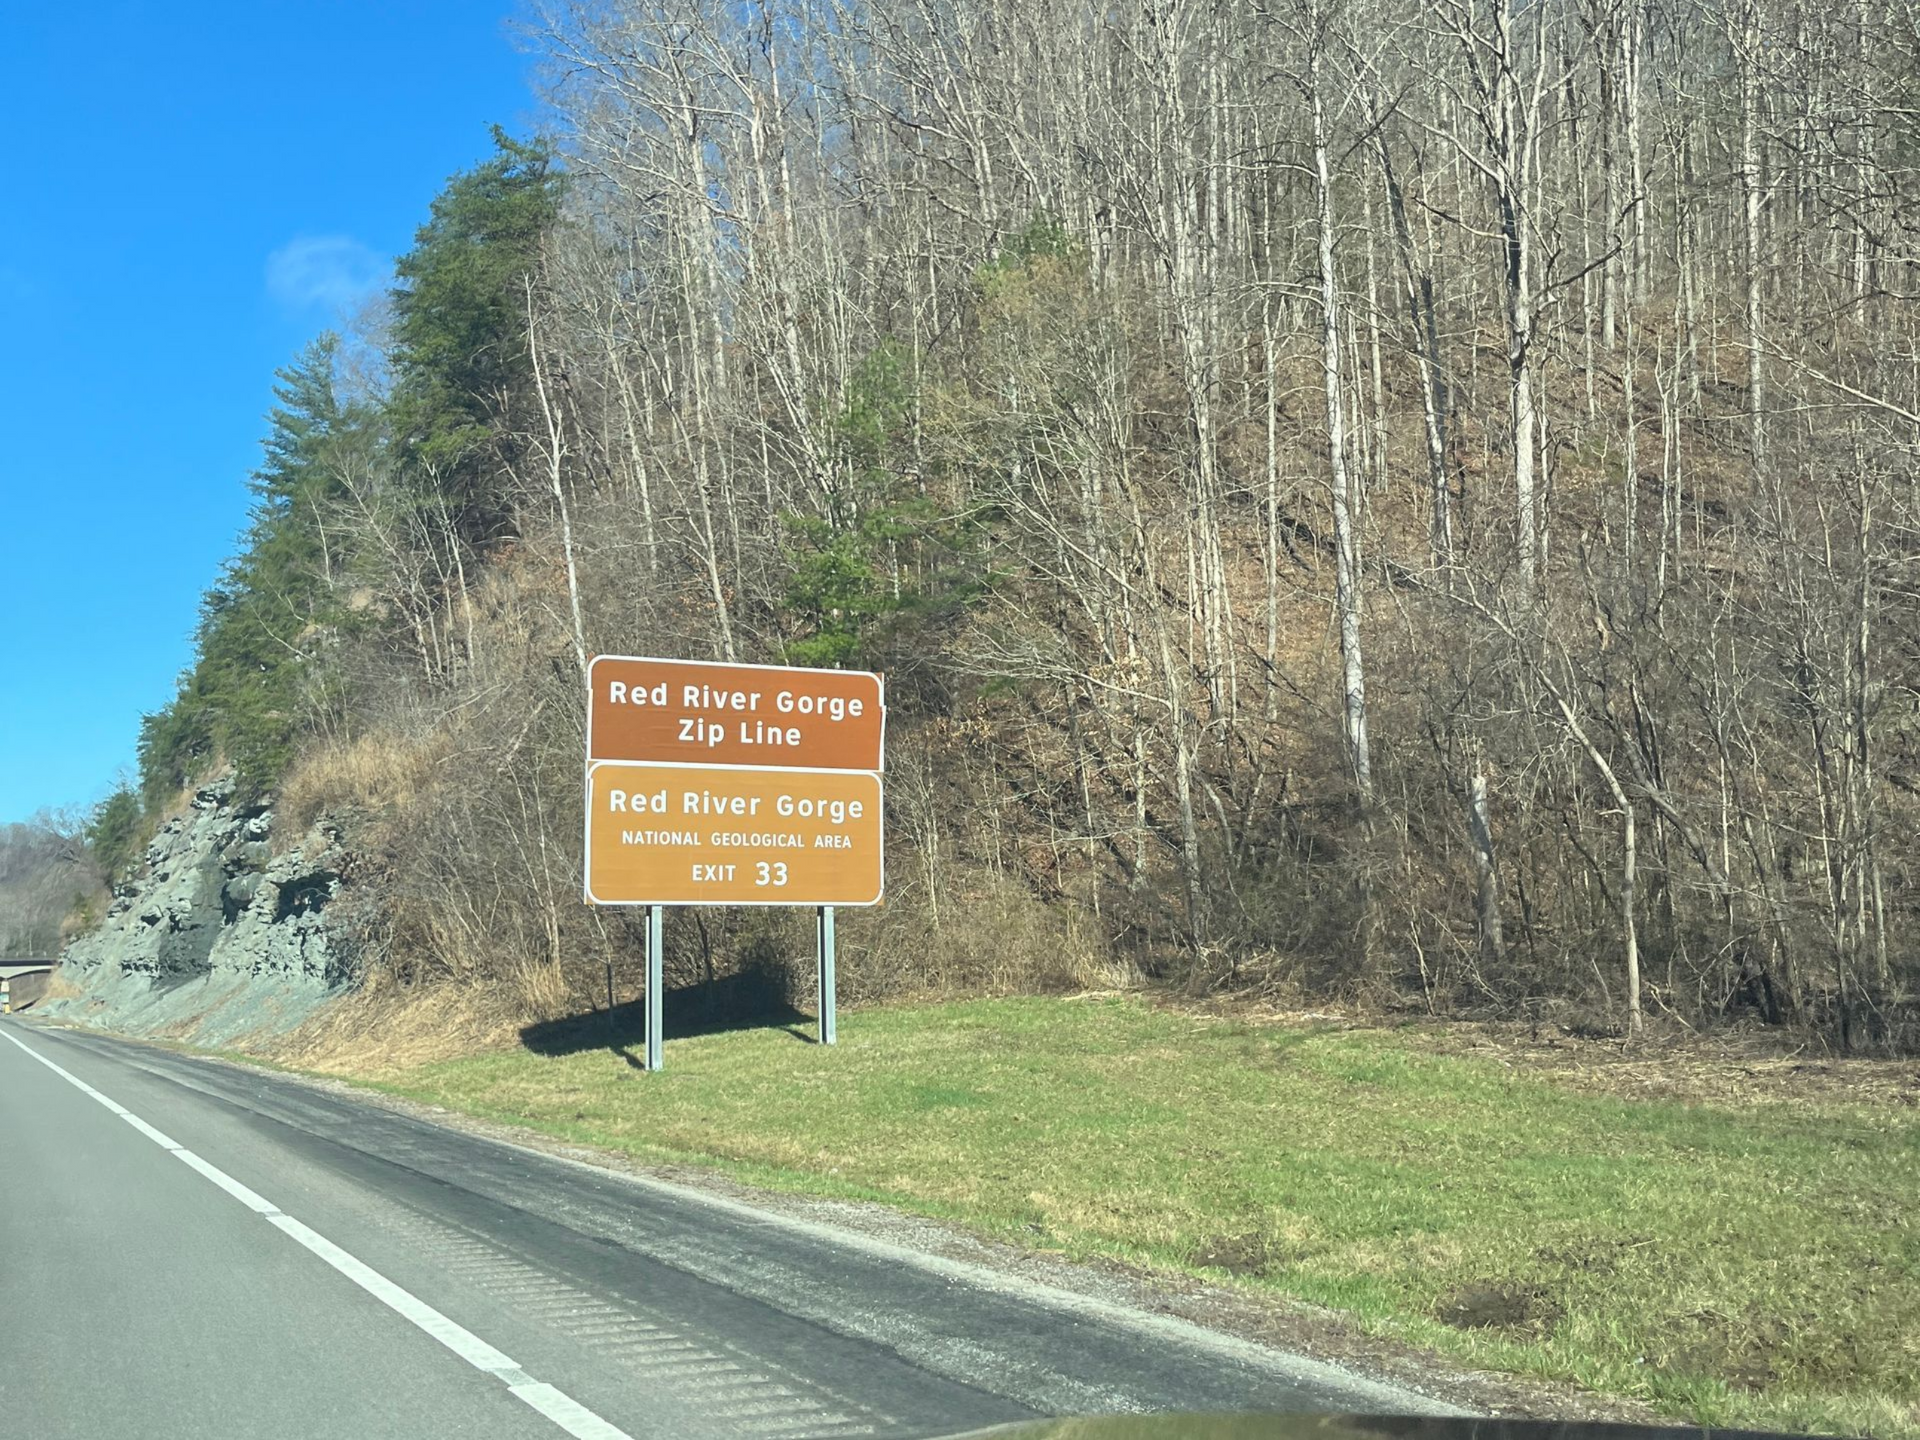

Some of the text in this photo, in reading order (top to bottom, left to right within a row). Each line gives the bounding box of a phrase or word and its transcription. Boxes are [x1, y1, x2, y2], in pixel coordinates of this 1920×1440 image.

[609, 681, 864, 721] Red River Gorge
[678, 719, 801, 747] Zip Line
[609, 790, 864, 824] Red River Gorge
[622, 831, 852, 849] NATIONAL GEOLOGICAL AREA
[692, 862, 788, 886] EXIT 33
